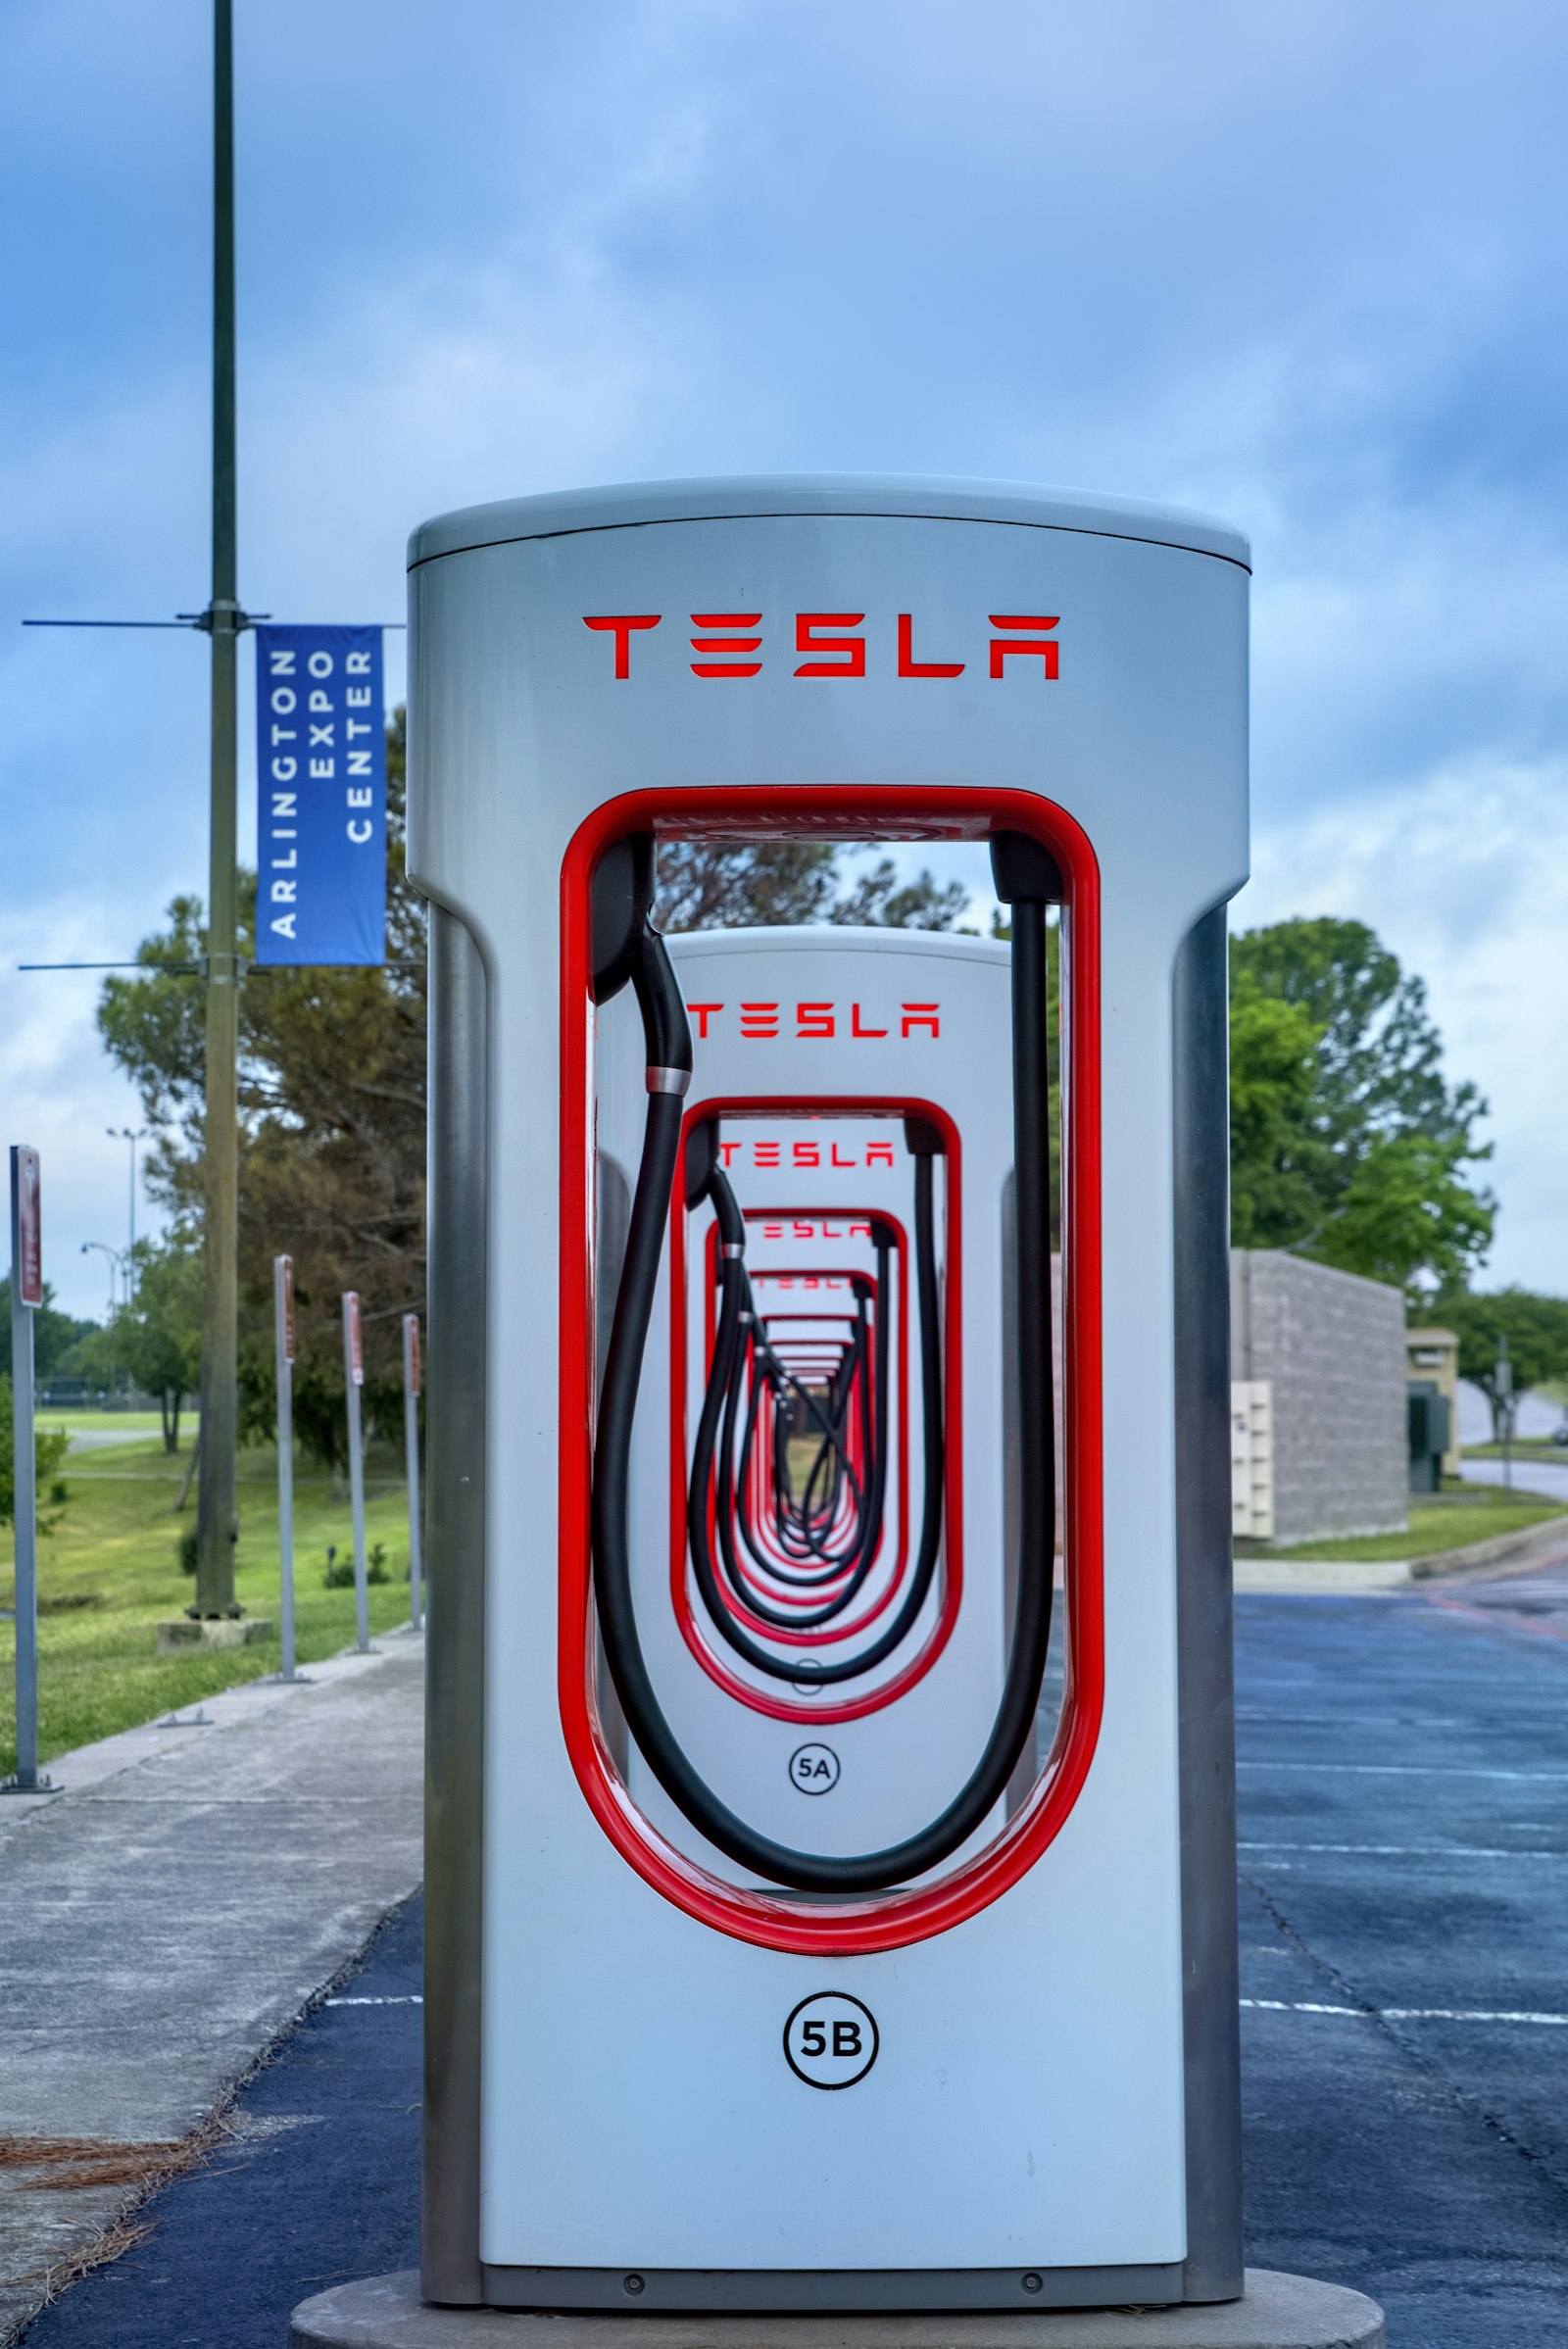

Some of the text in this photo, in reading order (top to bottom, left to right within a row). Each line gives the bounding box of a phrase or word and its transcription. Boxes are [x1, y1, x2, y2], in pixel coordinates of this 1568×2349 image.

[582, 612, 1060, 680] TESLA
[308, 651, 335, 779] EXPO
[346, 651, 373, 844] CENTER
[270, 650, 298, 940] ARLINGTON
[686, 1003, 941, 1039] TESLA
[720, 1142, 894, 1168] TESLA
[745, 1220, 871, 1239] ESLA
[798, 1758, 831, 1780] 5A
[800, 2020, 862, 2057] 5B
